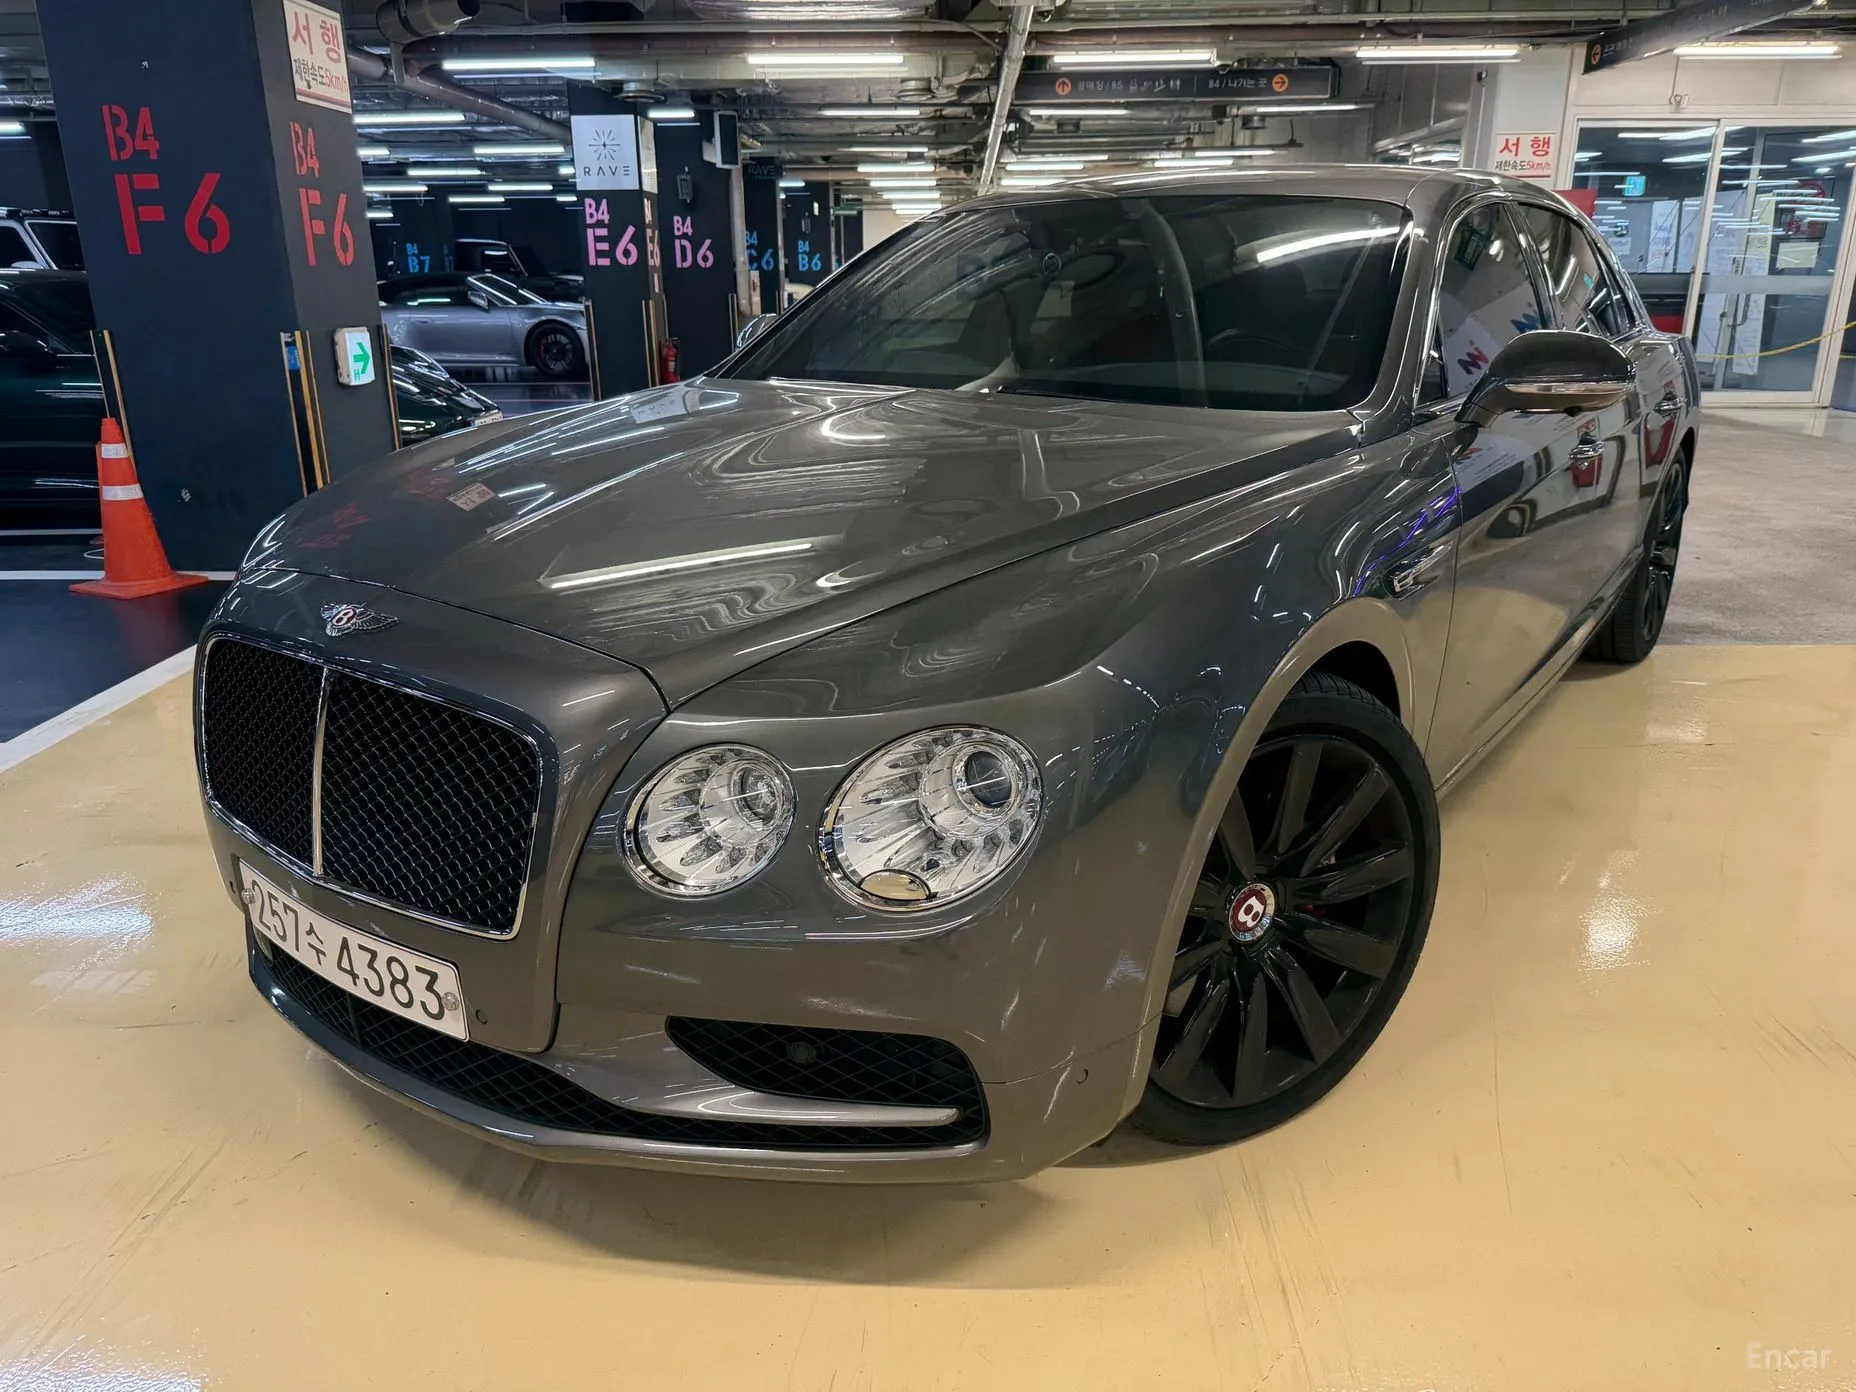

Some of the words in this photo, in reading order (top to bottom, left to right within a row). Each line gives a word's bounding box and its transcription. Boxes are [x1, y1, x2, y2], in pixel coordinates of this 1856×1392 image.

[102, 105, 159, 161] B4
[289, 121, 320, 177] B4
[583, 166, 631, 176] RAVE
[584, 198, 610, 224] B4
[673, 215, 693, 236] B4
[406, 243, 418, 255] B4
[586, 224, 638, 266] E6
[674, 239, 714, 268] D6
[797, 240, 809, 253] B4
[798, 253, 821, 271] B6
[337, 936, 445, 1021] 4383
